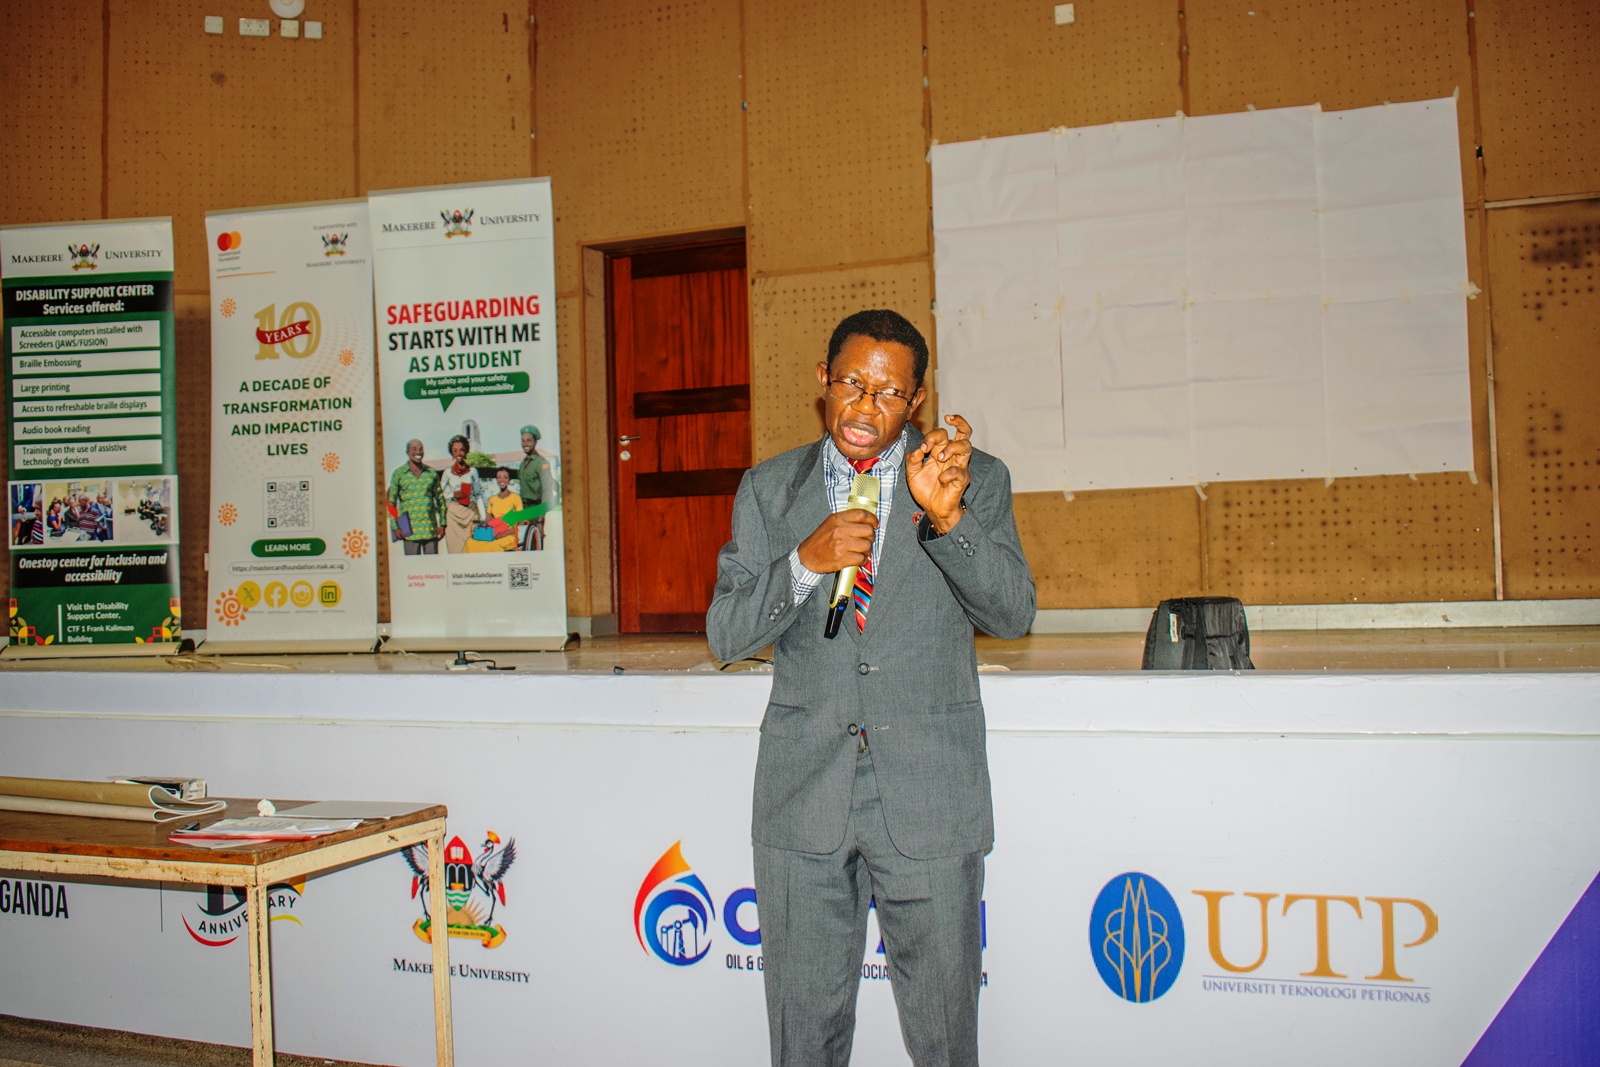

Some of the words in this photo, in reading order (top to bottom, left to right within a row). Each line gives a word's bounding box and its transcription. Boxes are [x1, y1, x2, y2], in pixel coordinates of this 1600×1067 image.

[382, 221, 436, 232] MAKERERE
[480, 214, 540, 225] UNIVERSITY
[12, 254, 64, 264] MAKERERE
[105, 250, 162, 259] UNIVERSITY
[16, 288, 70, 301] DISABILITY
[71, 286, 115, 299] SUPPORT
[116, 284, 154, 296] CENTER
[43, 303, 84, 315] Services
[86, 300, 124, 313] offered:
[387, 295, 540, 325] SAFEGUARDING
[20, 329, 57, 338] Accessible
[58, 328, 95, 338] computers
[96, 326, 125, 335] installed
[127, 325, 142, 333] with
[254, 302, 322, 361] 10
[265, 323, 302, 343] YEARS
[388, 328, 454, 351] STARTS
[457, 324, 507, 346] WITH
[512, 322, 540, 342] ME
[19, 339, 53, 349] Screeders
[55, 338, 108, 350] (JAWS/FUSION)
[20, 360, 42, 368] Braille
[44, 358, 82, 368] Embossing
[409, 356, 429, 373] AS
[434, 355, 444, 371] A
[448, 350, 522, 370] STUDENT
[239, 381, 249, 392] A
[252, 378, 310, 392] DECADE
[314, 376, 331, 388] OF
[438, 377, 456, 385] safety
[457, 376, 470, 384] and
[487, 374, 507, 382] safety
[20, 384, 40, 394] Large
[42, 382, 70, 393] printing
[421, 388, 427, 396] is
[440, 386, 469, 394] collective
[471, 384, 514, 394] responsibility
[22, 405, 45, 413] Access
[55, 402, 95, 411] refreshable
[96, 401, 118, 410] braille
[120, 400, 147, 410] displays
[223, 397, 352, 414] TRANSFORMATION
[22, 426, 43, 434] Audio
[44, 425, 62, 434] book
[64, 424, 91, 434] reading
[231, 424, 261, 436] AND
[265, 420, 342, 434] IMPACTING
[23, 446, 51, 456] Training
[64, 445, 75, 453] the
[90, 444, 97, 452] of
[98, 443, 127, 452] assistive
[267, 443, 308, 456] LIVES
[23, 458, 62, 468] technology
[64, 457, 89, 465] devices
[264, 544, 288, 552] LEARN
[290, 543, 311, 551] MORE
[19, 557, 58, 571] Onestop
[60, 557, 90, 568] center
[90, 555, 104, 570] for
[105, 553, 147, 566] inclusion
[148, 552, 168, 565] and
[65, 570, 122, 584] accessibility
[97, 602, 129, 610] Disability
[67, 612, 94, 620] Support
[0, 879, 69, 919] GANDA
[198, 895, 297, 934] ANNIVEARY
[1192, 889, 1438, 982] UTP
[726, 953, 743, 969] OIL
[746, 955, 754, 970] &
[393, 958, 456, 976] MAKEE
[459, 964, 530, 983] UNIVERSITY
[1202, 980, 1275, 995] UNIVERSITI
[1281, 984, 1356, 999] TEKNOLOGI
[1361, 988, 1431, 1004] PETRONAS
